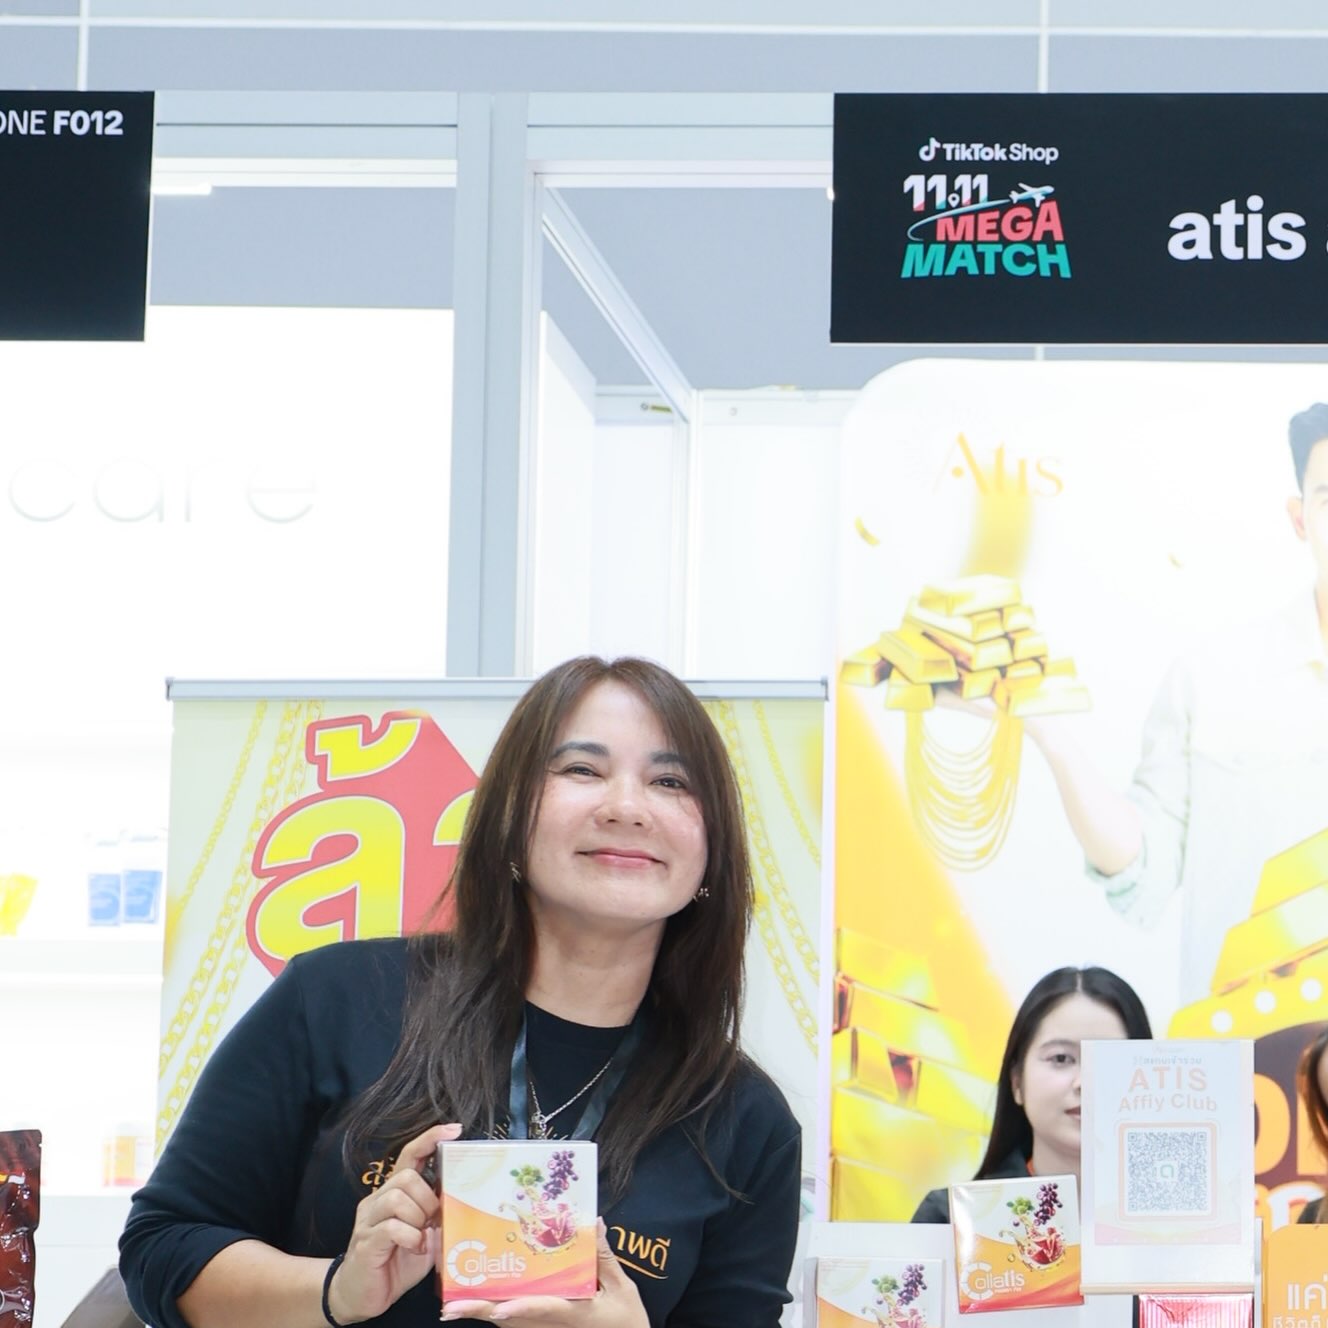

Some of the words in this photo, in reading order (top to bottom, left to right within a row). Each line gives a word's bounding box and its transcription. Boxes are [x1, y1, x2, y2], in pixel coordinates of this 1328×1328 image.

[53, 110, 124, 135] F012
[942, 143, 1006, 161] TikTok
[1009, 143, 1059, 165] Shop
[904, 174, 988, 212] 11.11
[936, 201, 1064, 242] MEGA
[1168, 195, 1307, 260] atis
[901, 243, 1072, 278] MATCH
[1128, 1066, 1207, 1091] ATIS
[1171, 1093, 1218, 1111] Club
[961, 1262, 1025, 1301] Collatis
